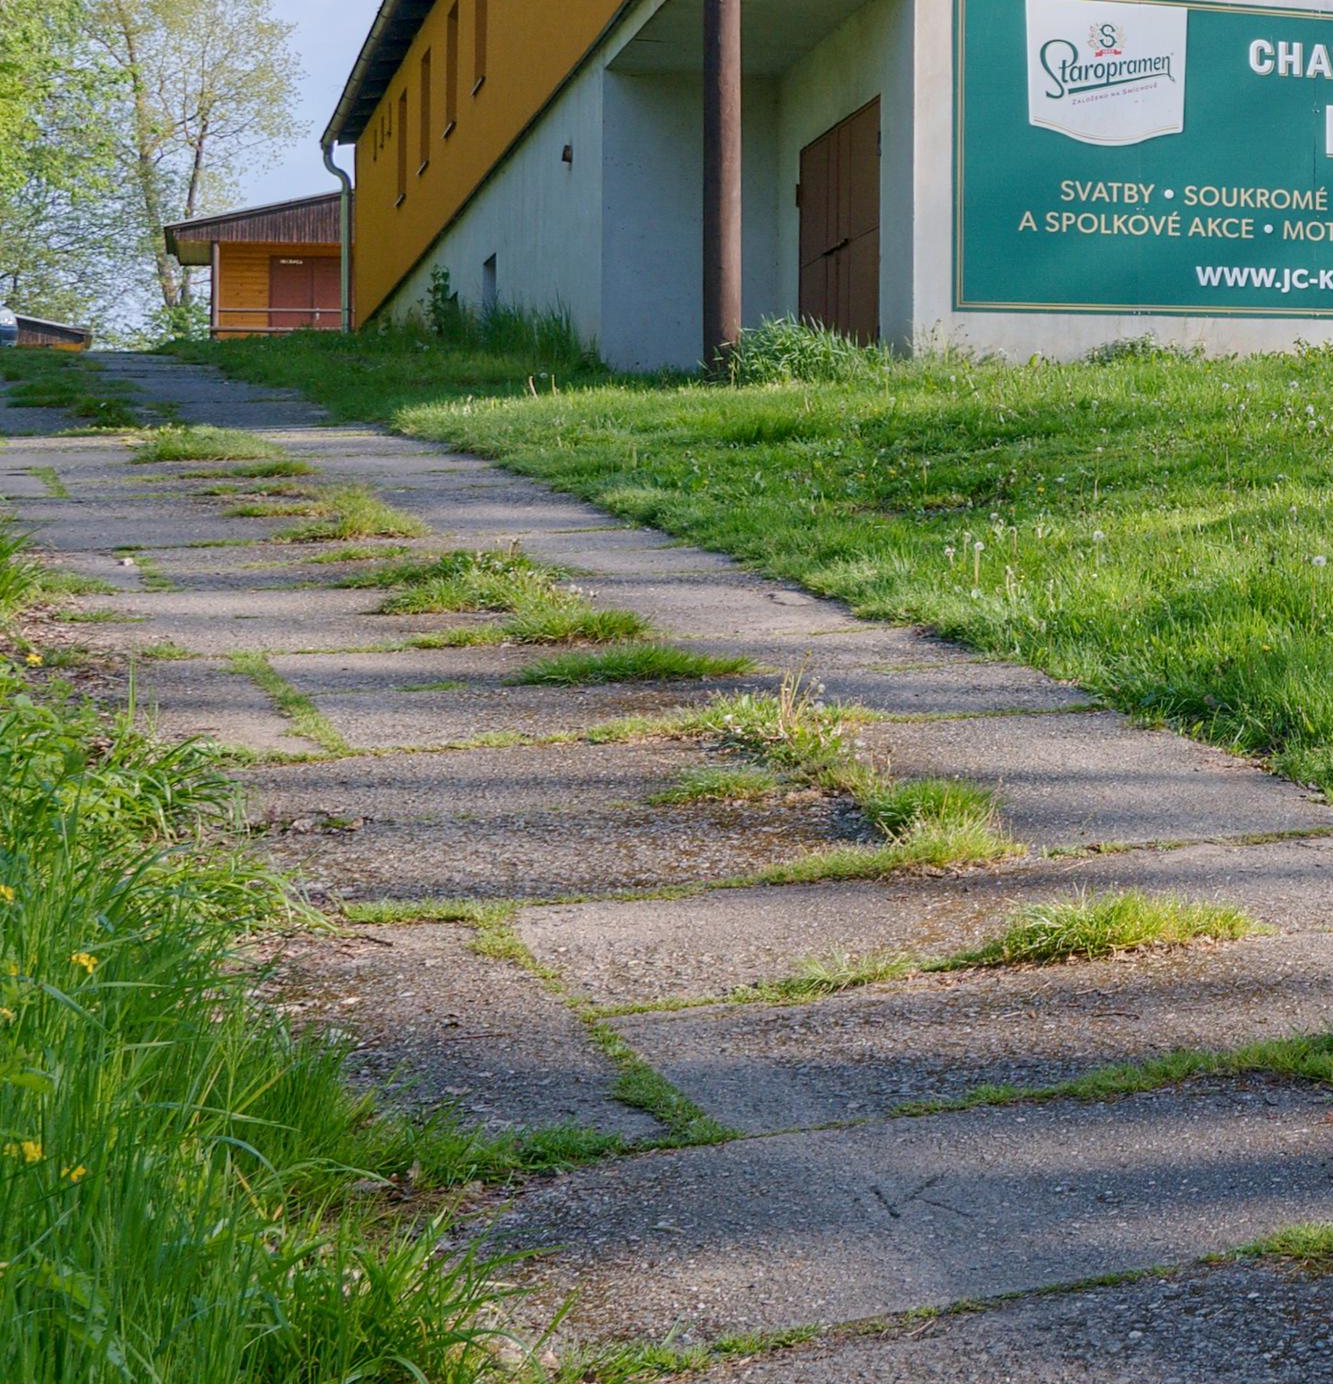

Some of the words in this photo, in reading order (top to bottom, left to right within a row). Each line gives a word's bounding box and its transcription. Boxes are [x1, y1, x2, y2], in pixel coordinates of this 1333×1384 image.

[1039, 39, 1176, 99] Staropramen
[1060, 180, 1155, 204] SVATBY
[1184, 185, 1328, 212] SOUKROMÉ
[1018, 211, 1038, 232] A
[1045, 211, 1181, 237] SPOLKOVÉ
[1188, 218, 1254, 239] AKCE
